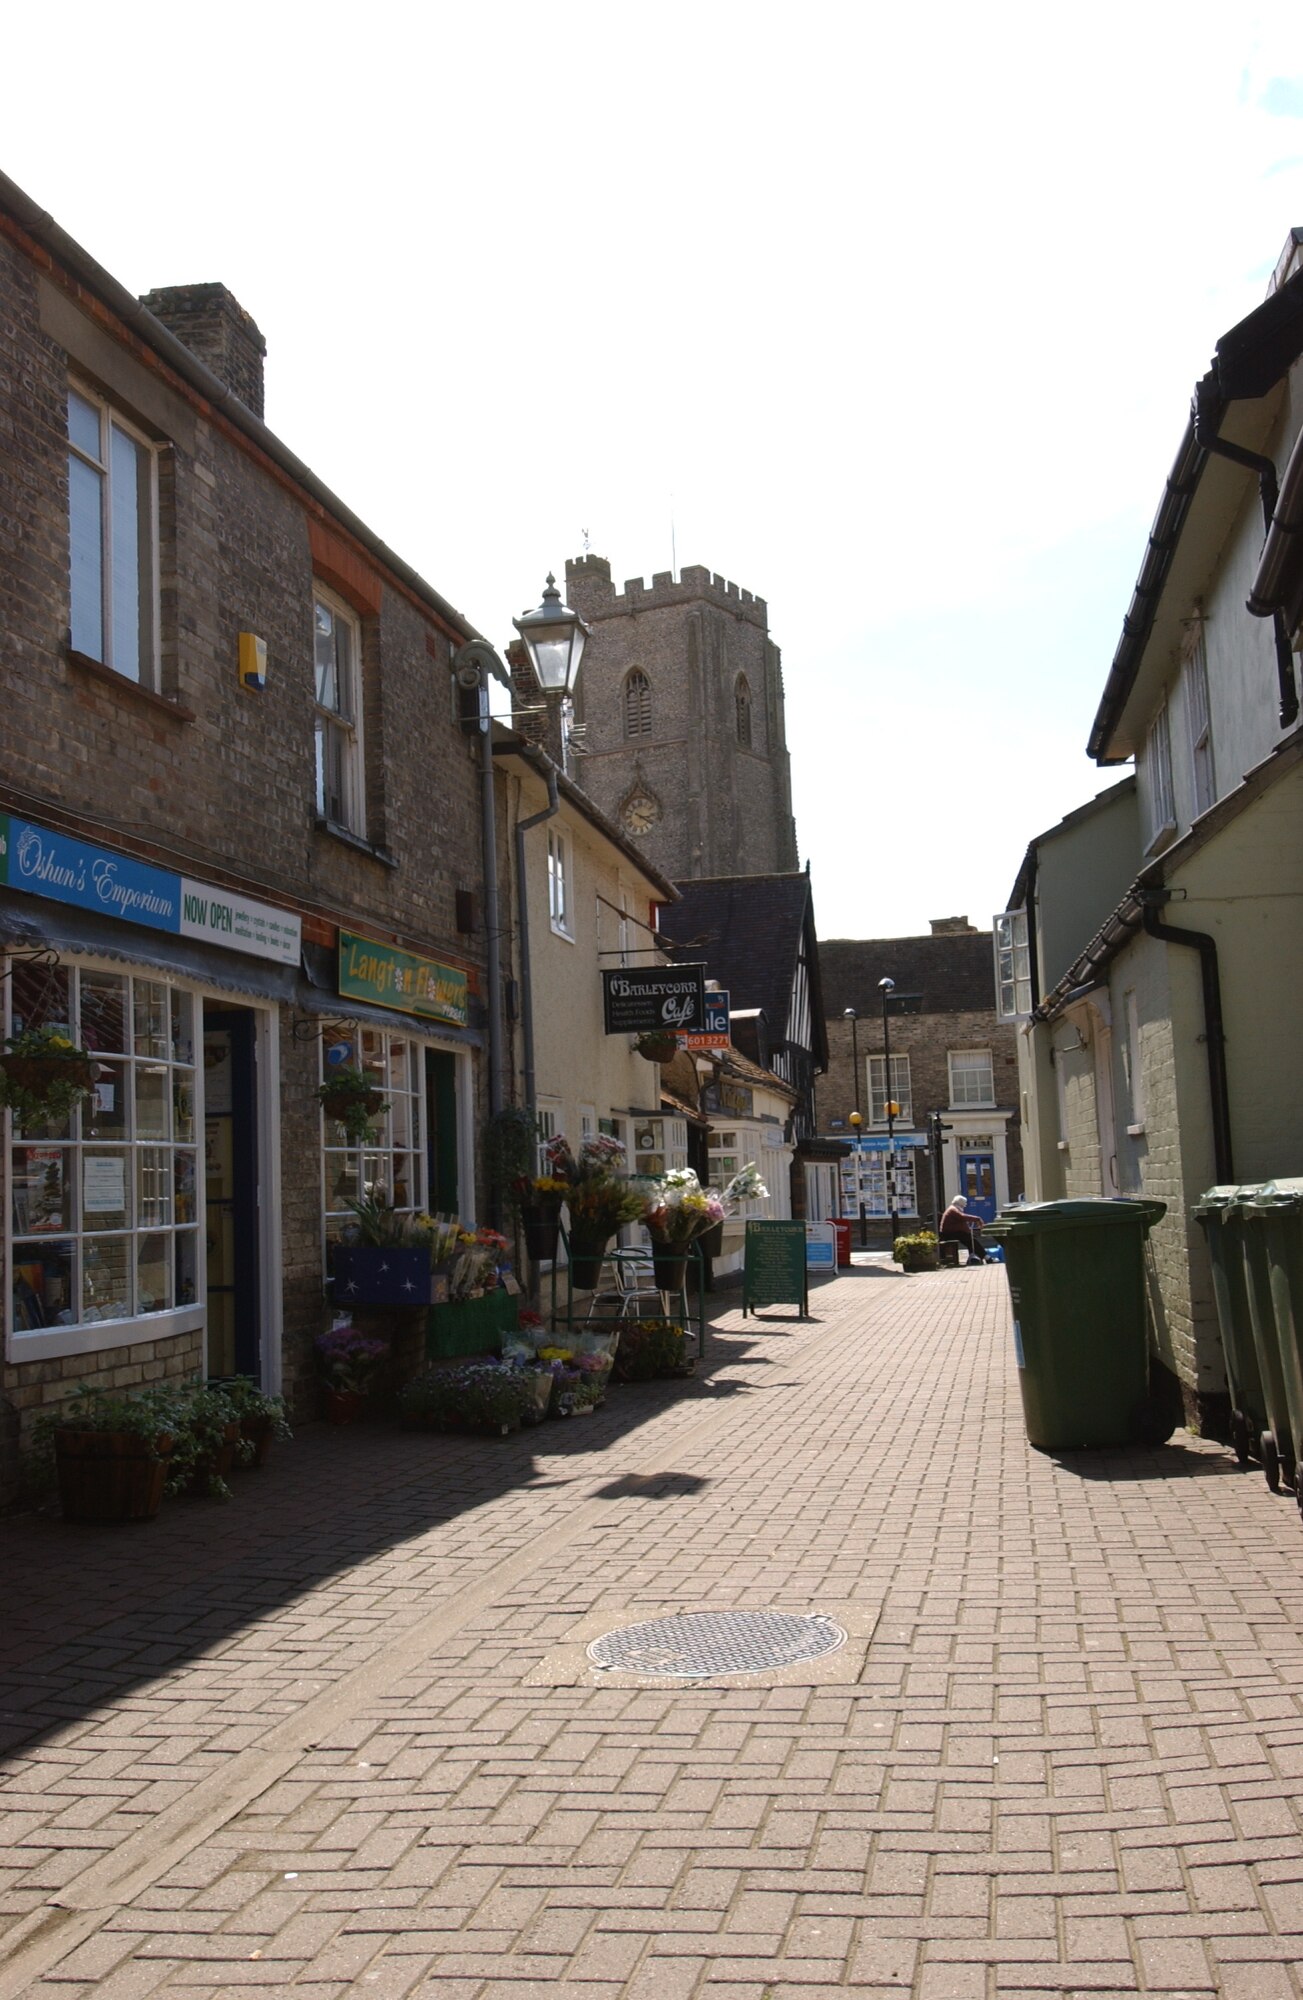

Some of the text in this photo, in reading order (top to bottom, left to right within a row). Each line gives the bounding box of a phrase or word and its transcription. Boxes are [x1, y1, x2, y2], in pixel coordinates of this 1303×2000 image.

[17, 828, 174, 918] Oshun's Emporium
[184, 893, 233, 934] NOW OPEN
[661, 996, 696, 1027] Café
